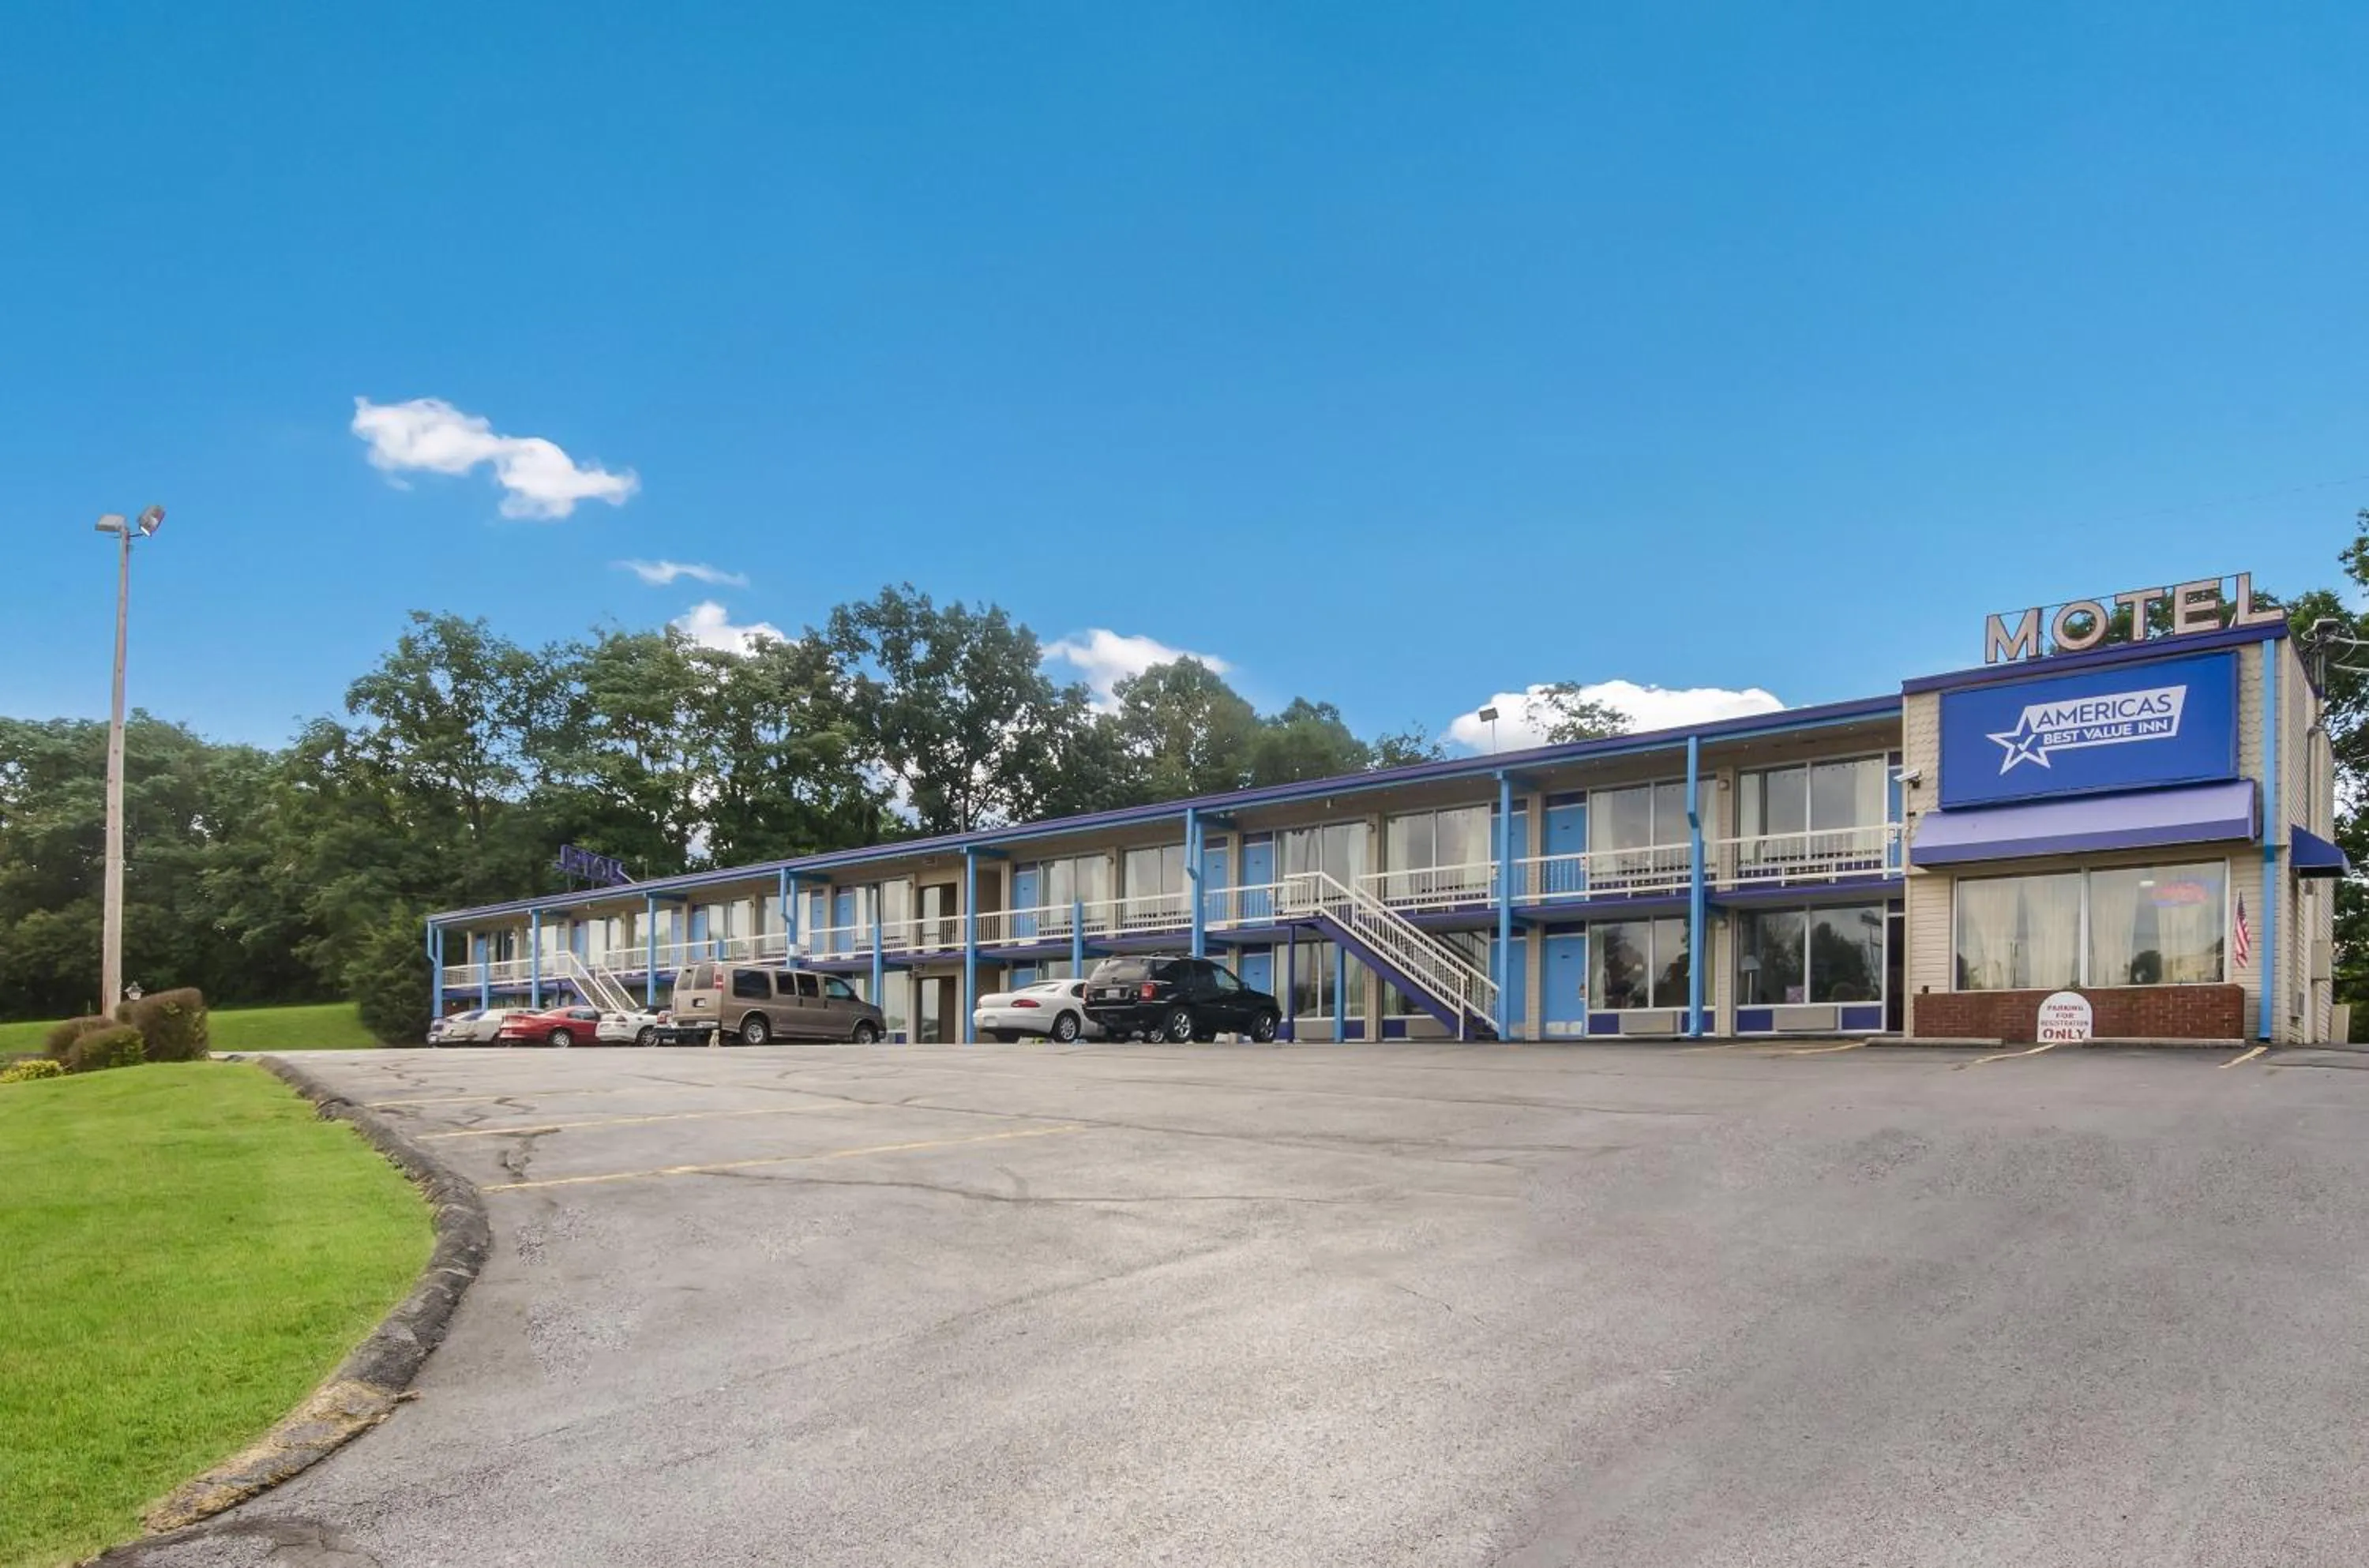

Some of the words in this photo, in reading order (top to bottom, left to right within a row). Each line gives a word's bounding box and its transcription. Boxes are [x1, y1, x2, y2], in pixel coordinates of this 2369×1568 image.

[1985, 572, 2285, 663] MOTEL
[2037, 694, 2172, 728] AMERICAS
[2043, 729, 2078, 745] BEST
[2083, 724, 2132, 740] VALUE
[2138, 719, 2168, 733] INN
[2043, 1028, 2086, 1040] ONLY
